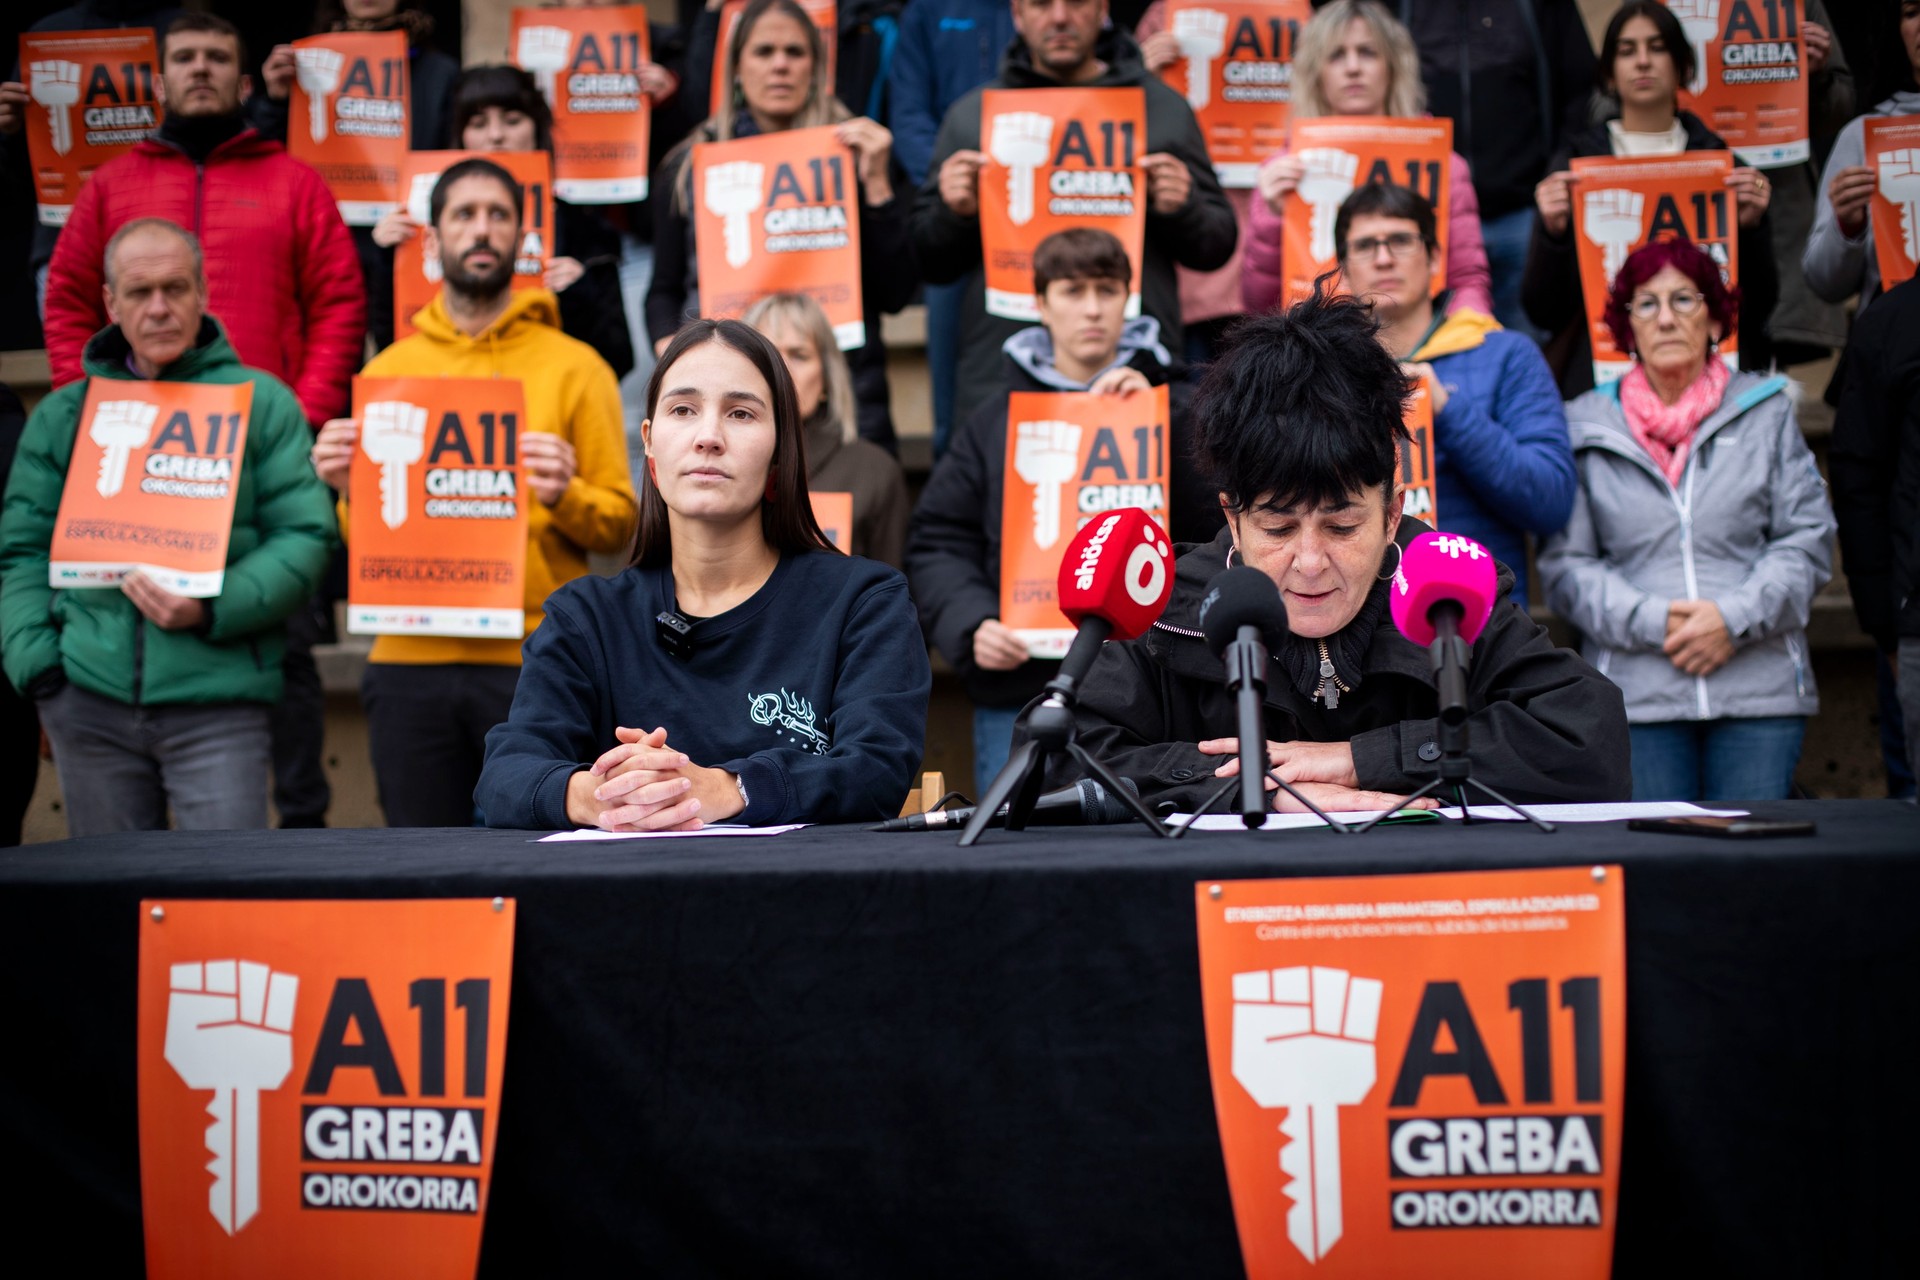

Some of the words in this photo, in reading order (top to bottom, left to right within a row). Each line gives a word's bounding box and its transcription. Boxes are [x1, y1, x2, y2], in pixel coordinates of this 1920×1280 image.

[1723, 0, 1797, 41] A11
[572, 33, 639, 70] A11
[1724, 42, 1797, 65] GREBA
[86, 63, 154, 104] A11
[341, 57, 403, 96] A11
[1054, 120, 1134, 167] A11
[767, 156, 844, 207] A11
[1050, 170, 1133, 196] GREBA
[764, 205, 847, 233] GREBA
[1648, 192, 1728, 240] A11
[153, 410, 241, 454] A11
[429, 412, 516, 465] A11
[146, 454, 231, 480] GREBA
[1082, 425, 1163, 481] A11
[426, 469, 516, 497] GREBA
[1078, 485, 1165, 513] GREBA
[1074, 514, 1122, 591] ahötsa
[302, 978, 491, 1098] A11
[1388, 976, 1605, 1108] A11
[305, 1107, 481, 1163] GREBA
[1391, 1116, 1600, 1177] GREBA
[304, 1174, 477, 1212] OROKORRA
[1392, 1189, 1600, 1226] OROKORRA
